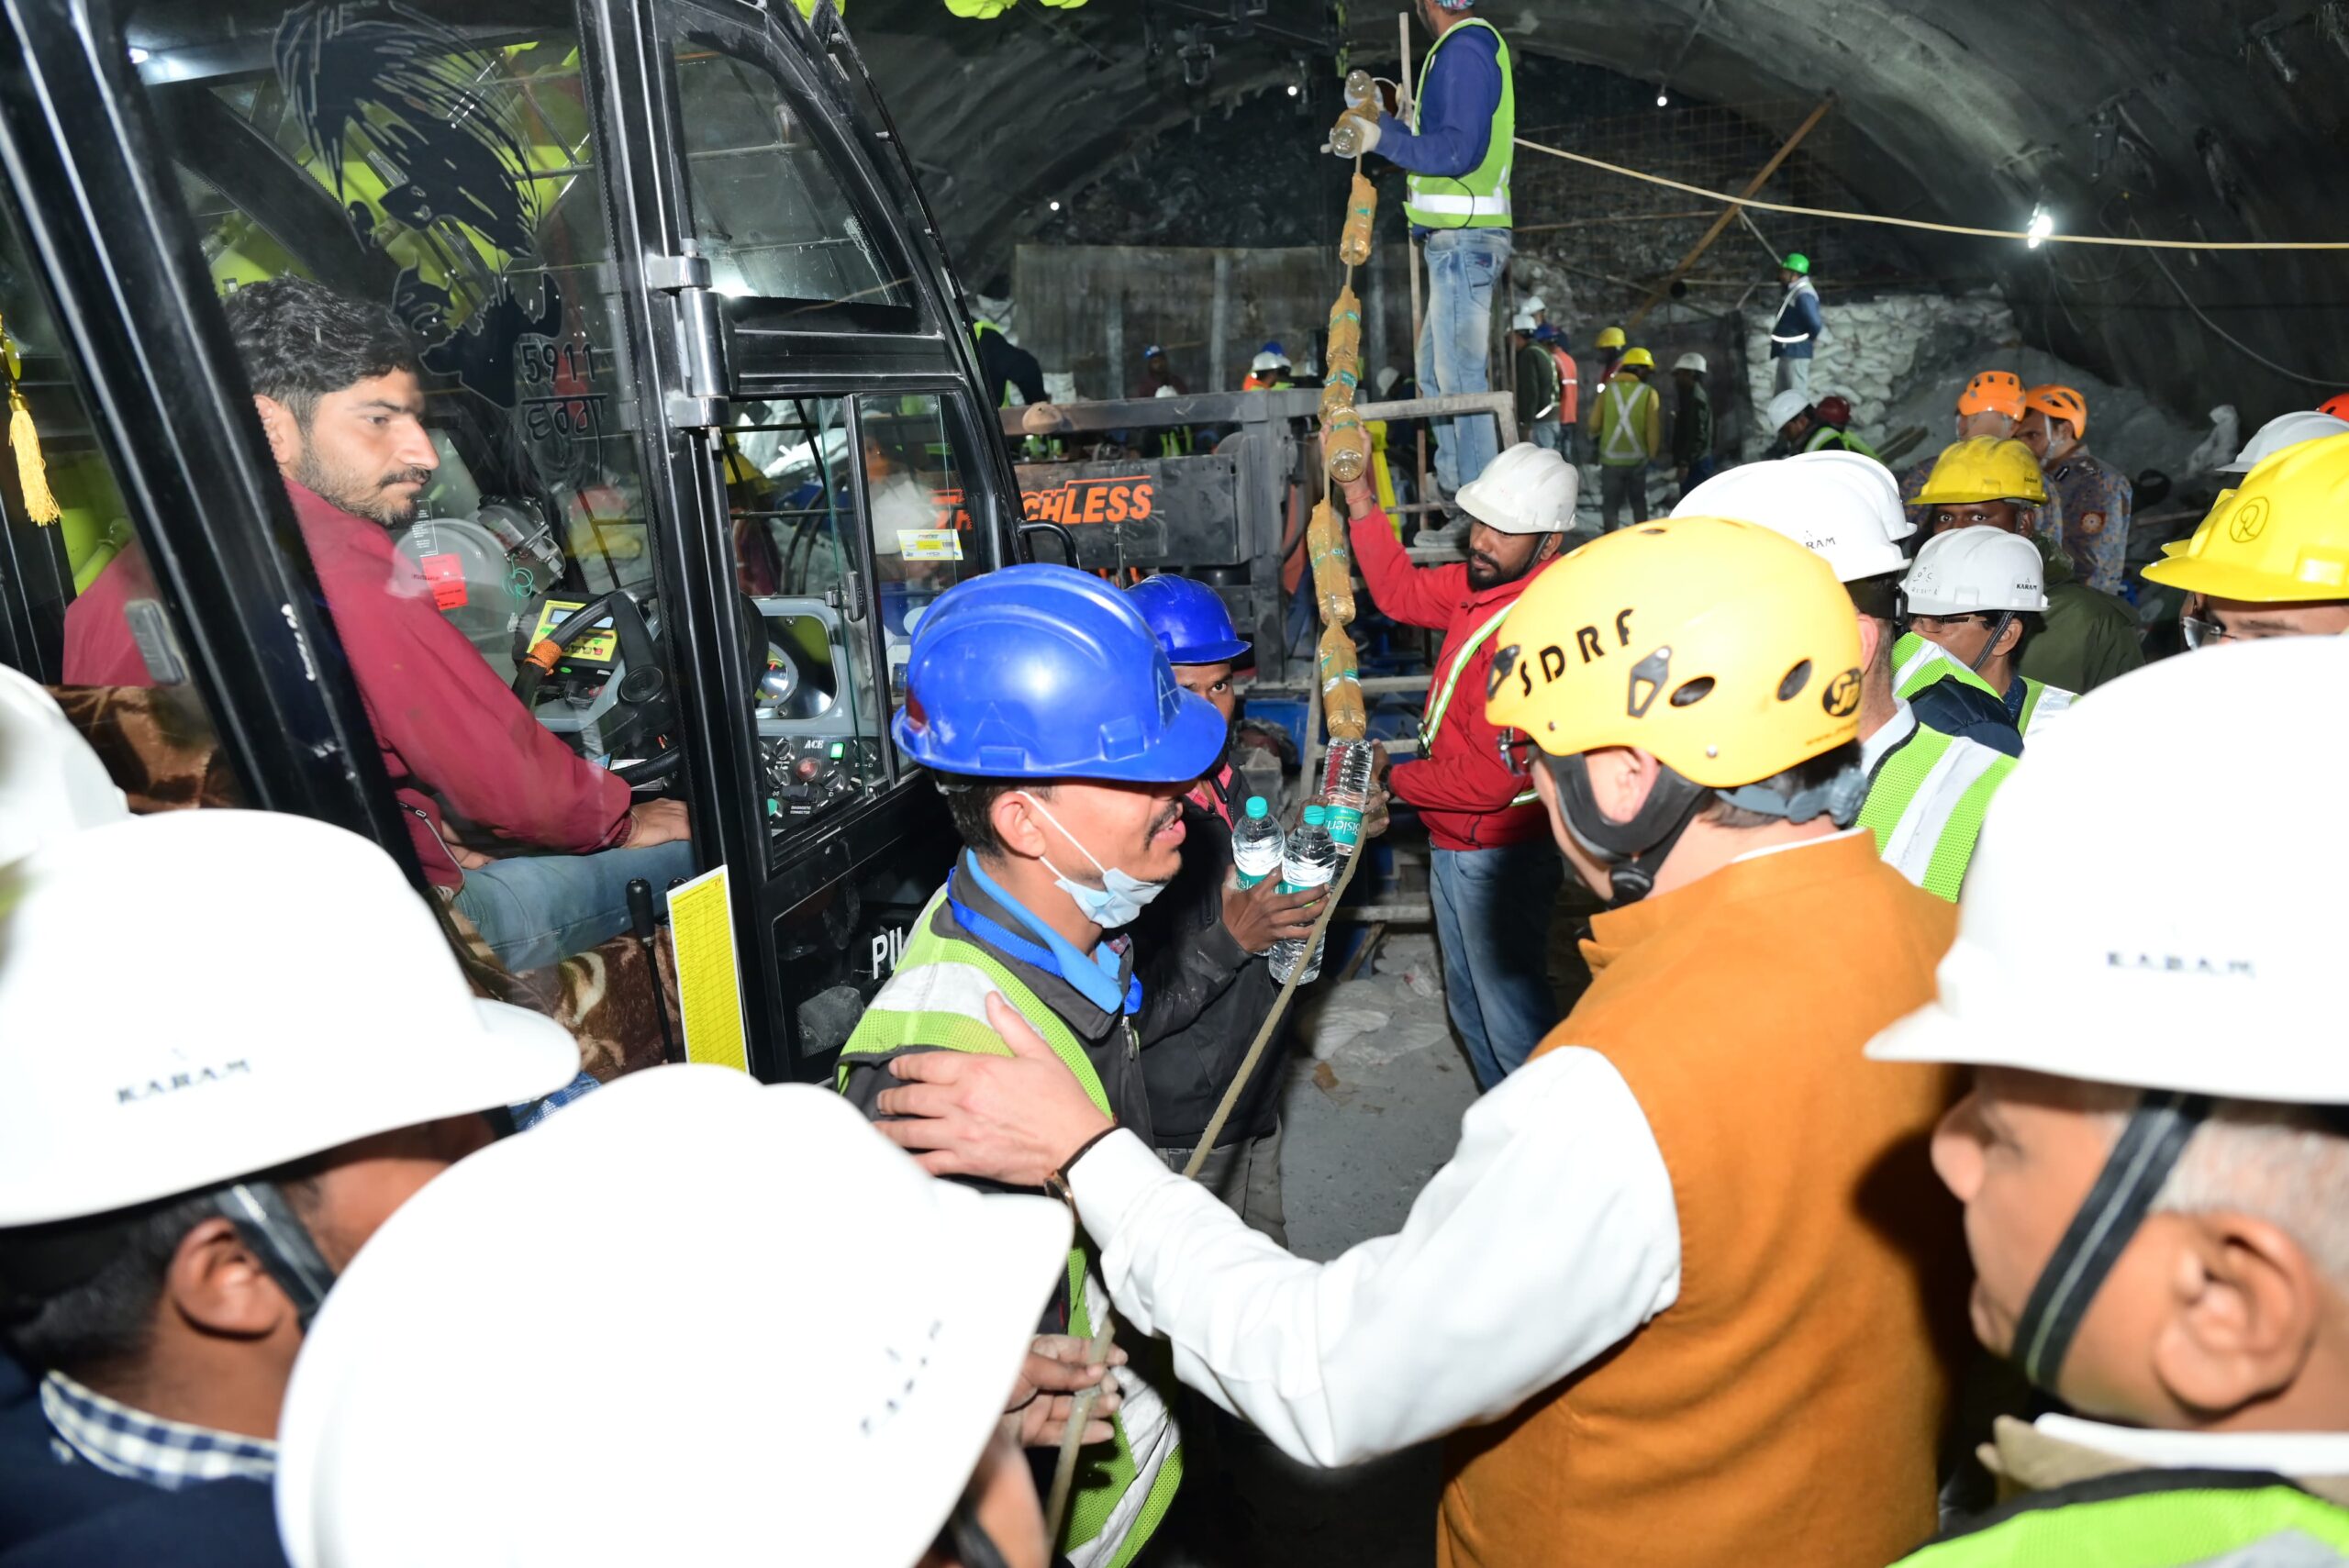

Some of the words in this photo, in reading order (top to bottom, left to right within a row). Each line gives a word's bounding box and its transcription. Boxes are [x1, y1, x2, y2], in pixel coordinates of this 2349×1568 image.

[520, 342, 596, 384] 5911
[1805, 537, 1836, 550] RAM
[1520, 608, 1634, 698] SDRF
[804, 740, 824, 749] ACE
